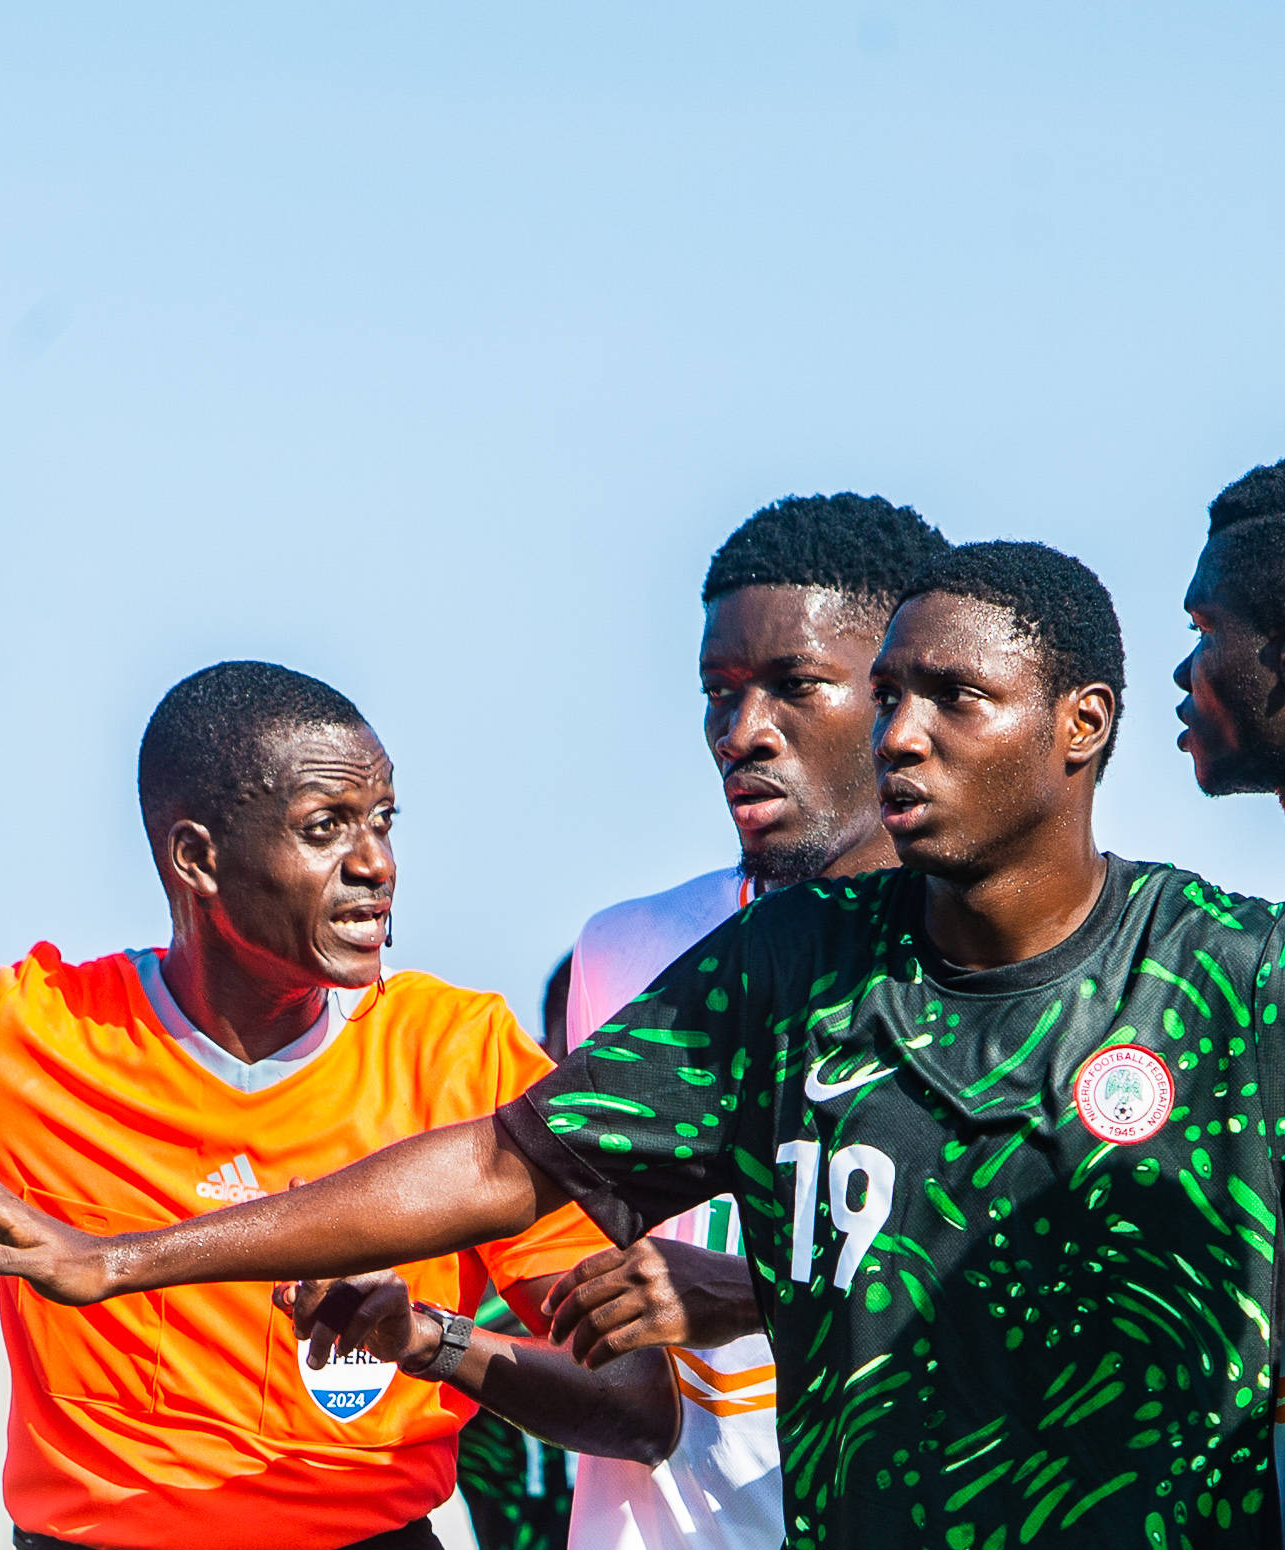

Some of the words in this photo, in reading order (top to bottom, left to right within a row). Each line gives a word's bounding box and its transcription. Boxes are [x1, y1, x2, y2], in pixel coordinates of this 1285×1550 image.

[1088, 1052, 1143, 1077] FOOTBALL
[1081, 1079, 1098, 1121] NIGERIA
[1146, 1061, 1168, 1127] FEDERATION
[1109, 1126, 1136, 1137] 1945
[775, 1139, 896, 1290] 19
[326, 1392, 366, 1408] 2024
